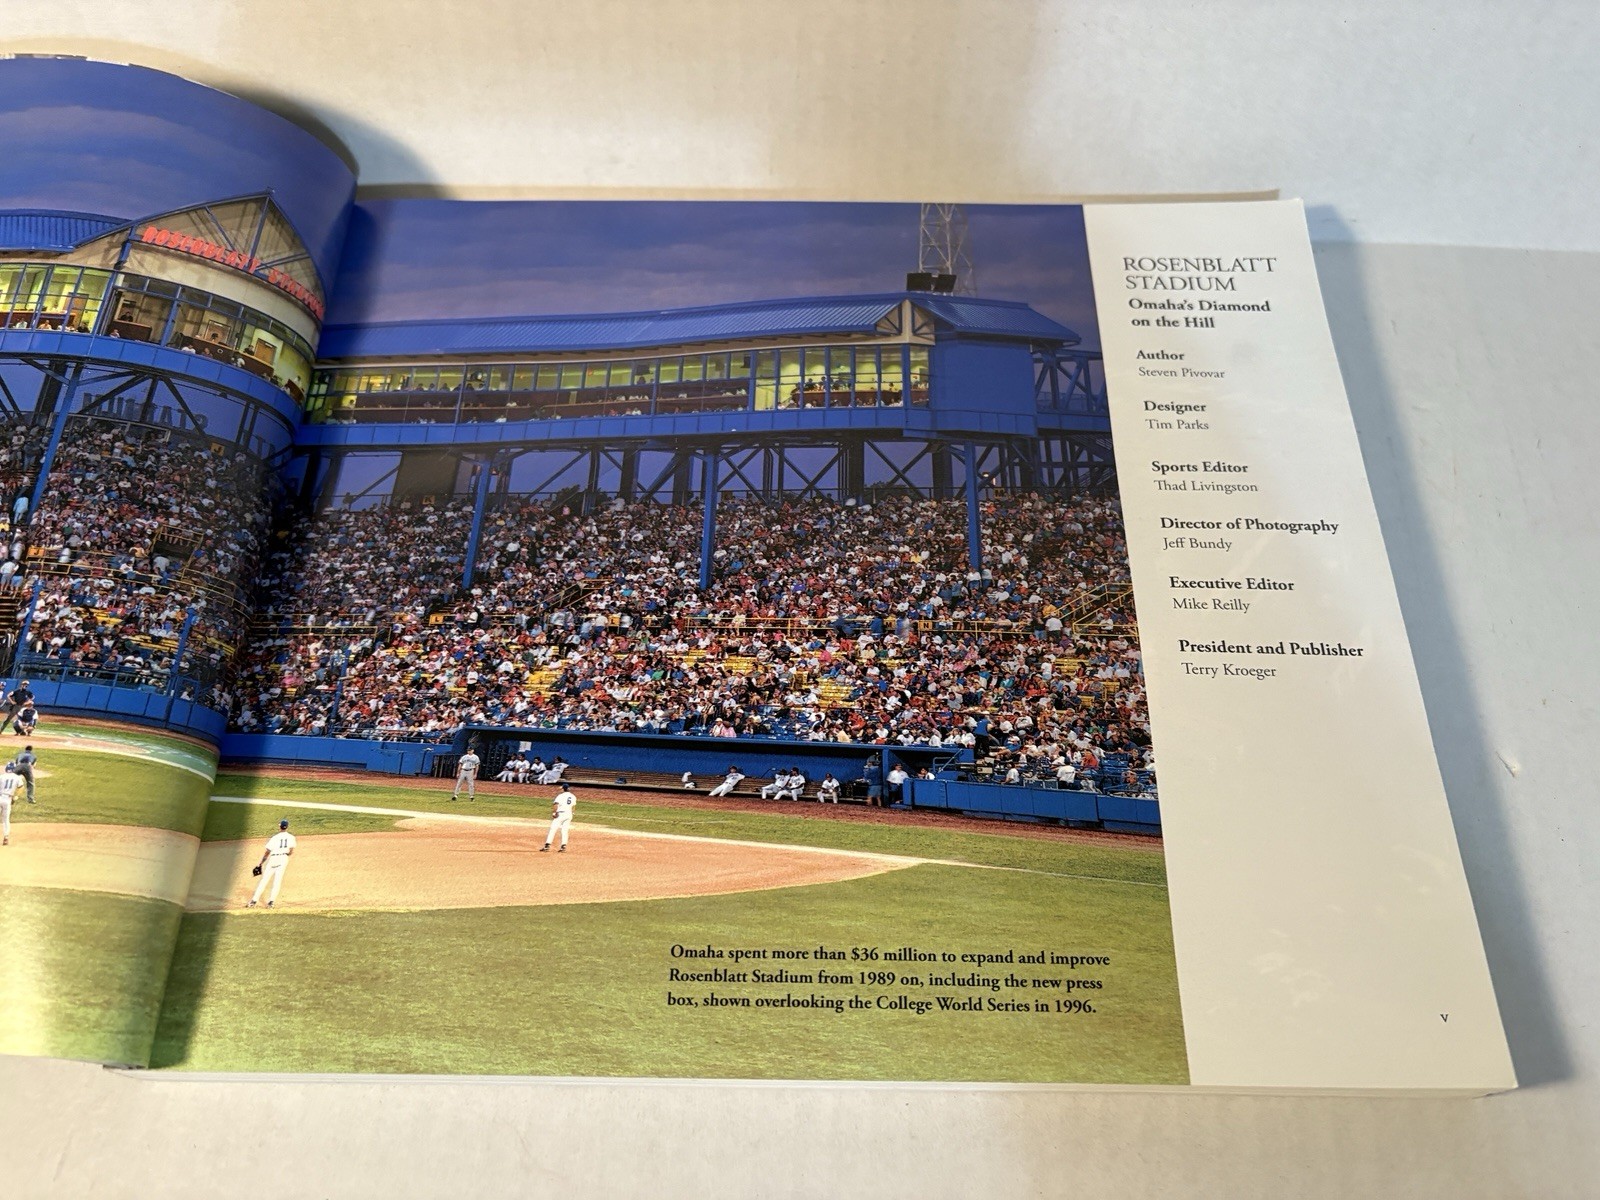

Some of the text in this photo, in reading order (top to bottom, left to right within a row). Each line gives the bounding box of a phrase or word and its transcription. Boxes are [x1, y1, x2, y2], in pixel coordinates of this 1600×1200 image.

[142, 226, 261, 274] ROSENBLATT
[1123, 257, 1276, 272] ROSENBLATT
[1126, 276, 1236, 291] STADIUM
[1129, 299, 1271, 311] Omaha's Diamond
[1156, 316, 1179, 327] the
[1184, 317, 1214, 328] Hill
[1137, 350, 1184, 360] Author
[1139, 367, 1225, 378] Steven Pivovar
[1144, 401, 1206, 414] Designer
[1145, 419, 1209, 429] Tim Parks
[1152, 461, 1248, 475] Sports Editor
[1154, 480, 1258, 494] Thad Livingston
[1161, 517, 1338, 534] Director of Photography
[1163, 537, 1232, 552] Jeff Bundy
[1169, 576, 1294, 590] Executive Editor
[1173, 598, 1250, 613] Mike Reilly
[1179, 640, 1363, 656] President and Publisher
[1181, 663, 1276, 680] Terry Kroeger
[280, 839, 288, 848] 11
[671, 944, 1110, 969] Omaha spent more than $36 million to expand and improve
[669, 968, 1103, 993] Rosenblatt Stadium from 1989 on, including the new press
[668, 992, 1096, 1014] box, shown overlooking the College World Series in 1996.
